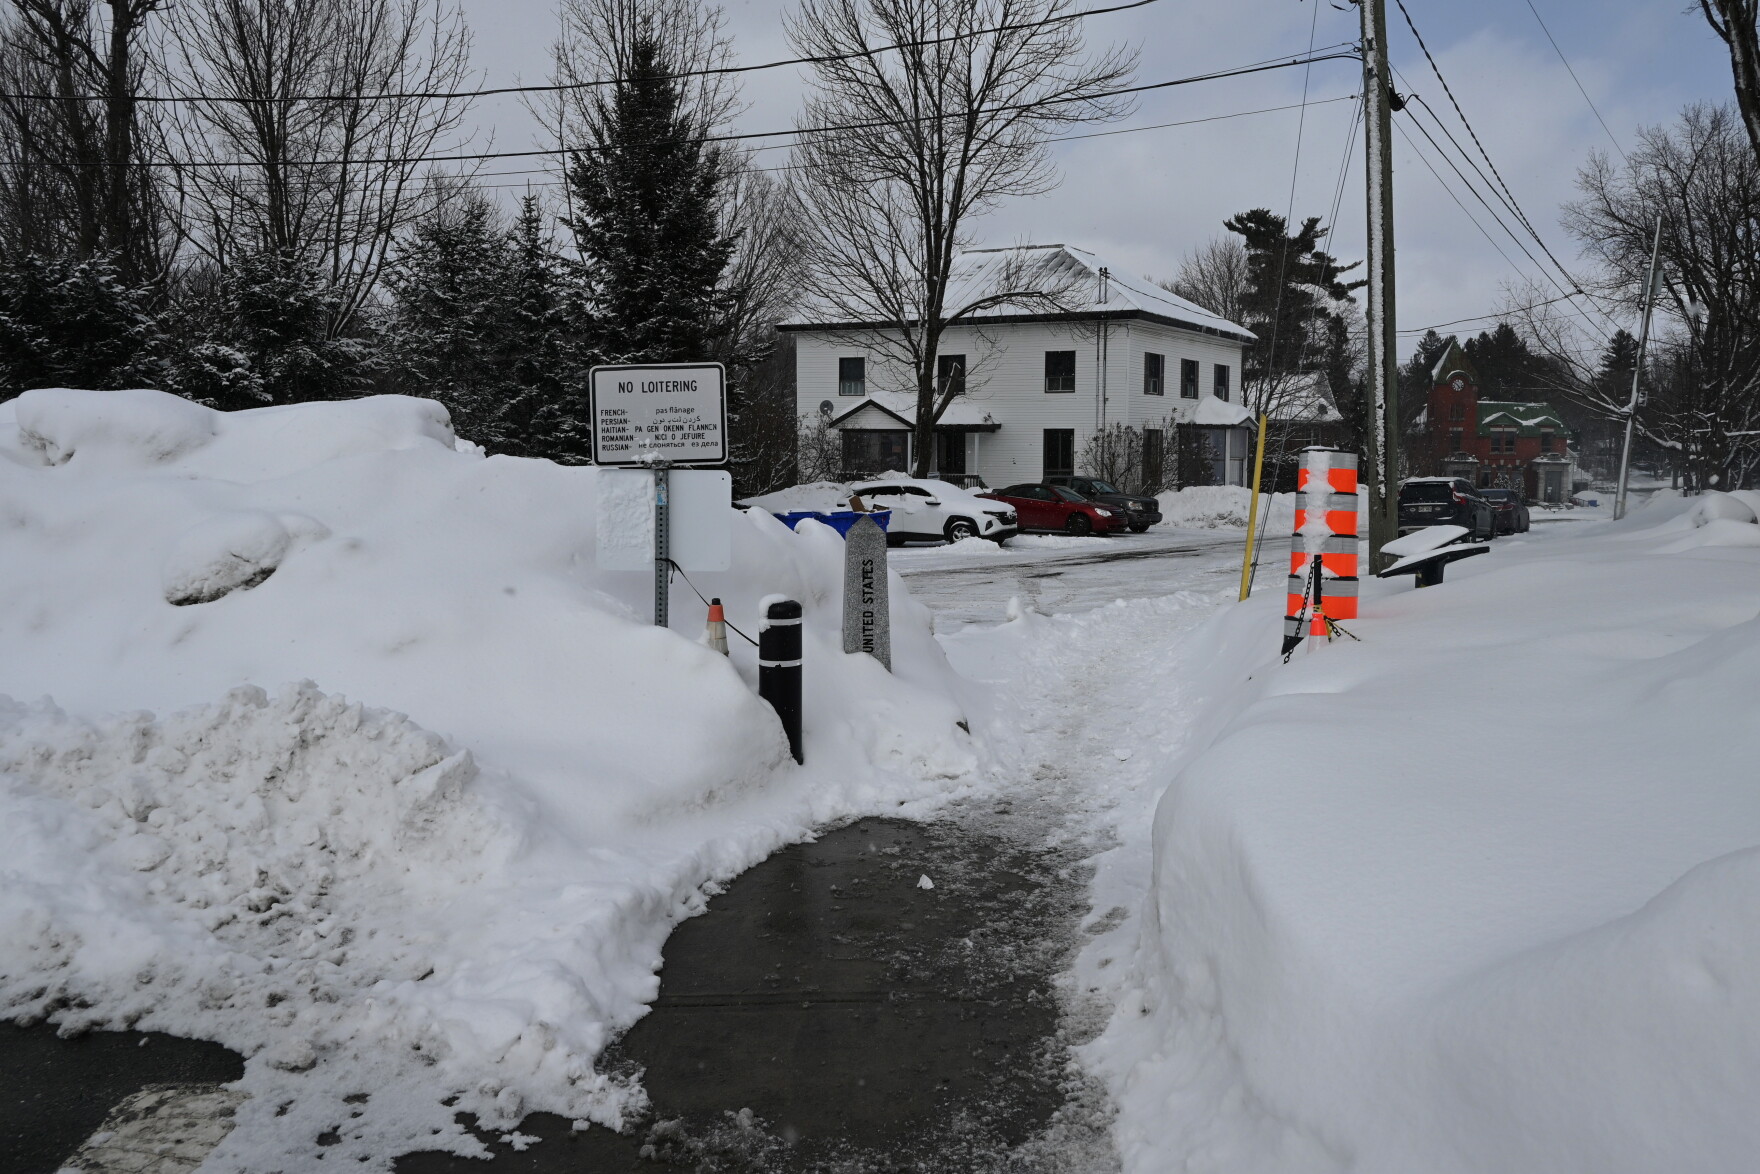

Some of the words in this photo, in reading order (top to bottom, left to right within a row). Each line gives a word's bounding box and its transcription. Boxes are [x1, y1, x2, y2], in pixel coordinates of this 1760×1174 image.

[618, 381, 634, 394] NO
[641, 380, 698, 393] LOITERING
[600, 409, 628, 417] FRENCH-
[601, 426, 629, 434] HAITIAN-
[634, 425, 643, 433] PA
[647, 425, 659, 433] GEN
[663, 424, 684, 432] OKENN
[602, 434, 637, 442] ROMANIAN-
[602, 443, 632, 451] RUSSIAN-
[862, 559, 874, 604] STATES
[862, 610, 874, 653] UNITED
